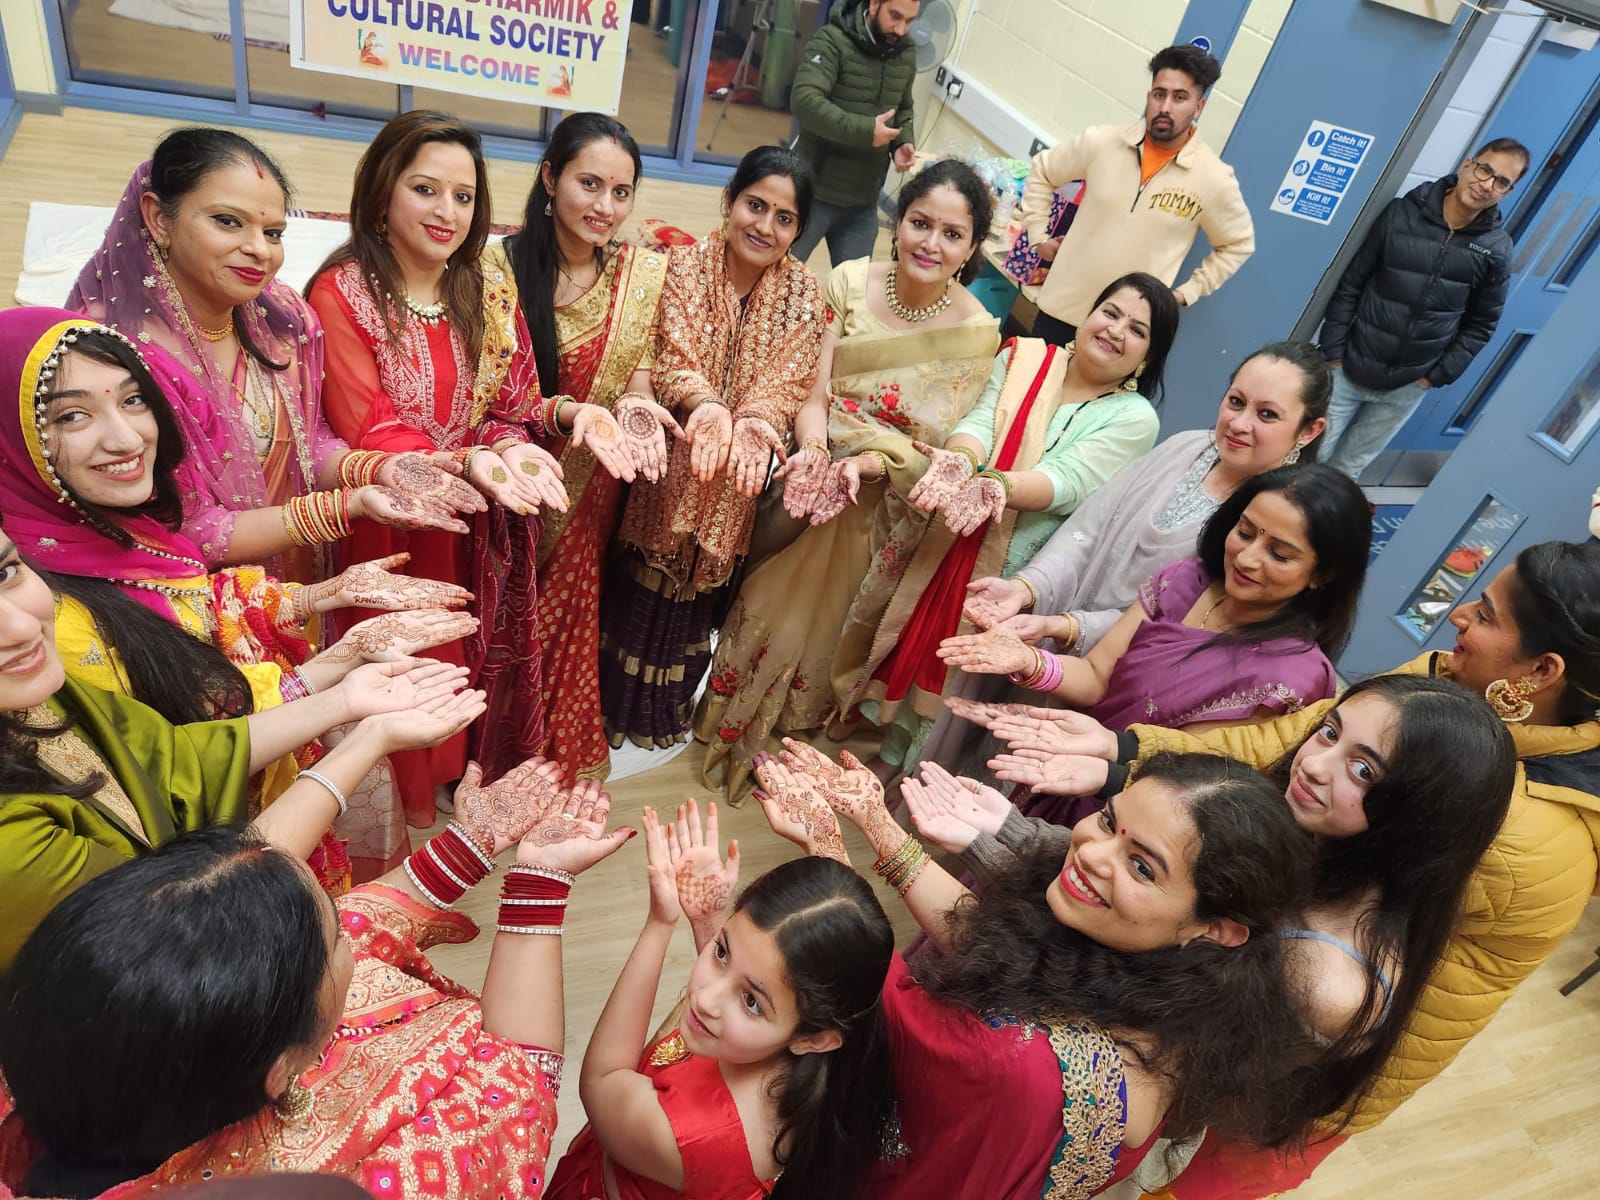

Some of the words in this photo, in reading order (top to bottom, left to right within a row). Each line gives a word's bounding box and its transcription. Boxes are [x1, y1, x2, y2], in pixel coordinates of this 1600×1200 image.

[465, 0, 592, 26] RMIK
[601, 0, 619, 30] &
[327, 0, 480, 42] CULTURAL
[489, 14, 605, 62] SOCIETY
[397, 42, 541, 87] WELCOME
[1331, 131, 1357, 146] Catch
[1357, 138, 1368, 149] it!
[1320, 162, 1336, 174] Bin
[1336, 167, 1346, 176] it!
[1148, 192, 1203, 221] TOMMY
[1306, 191, 1321, 202] Kill
